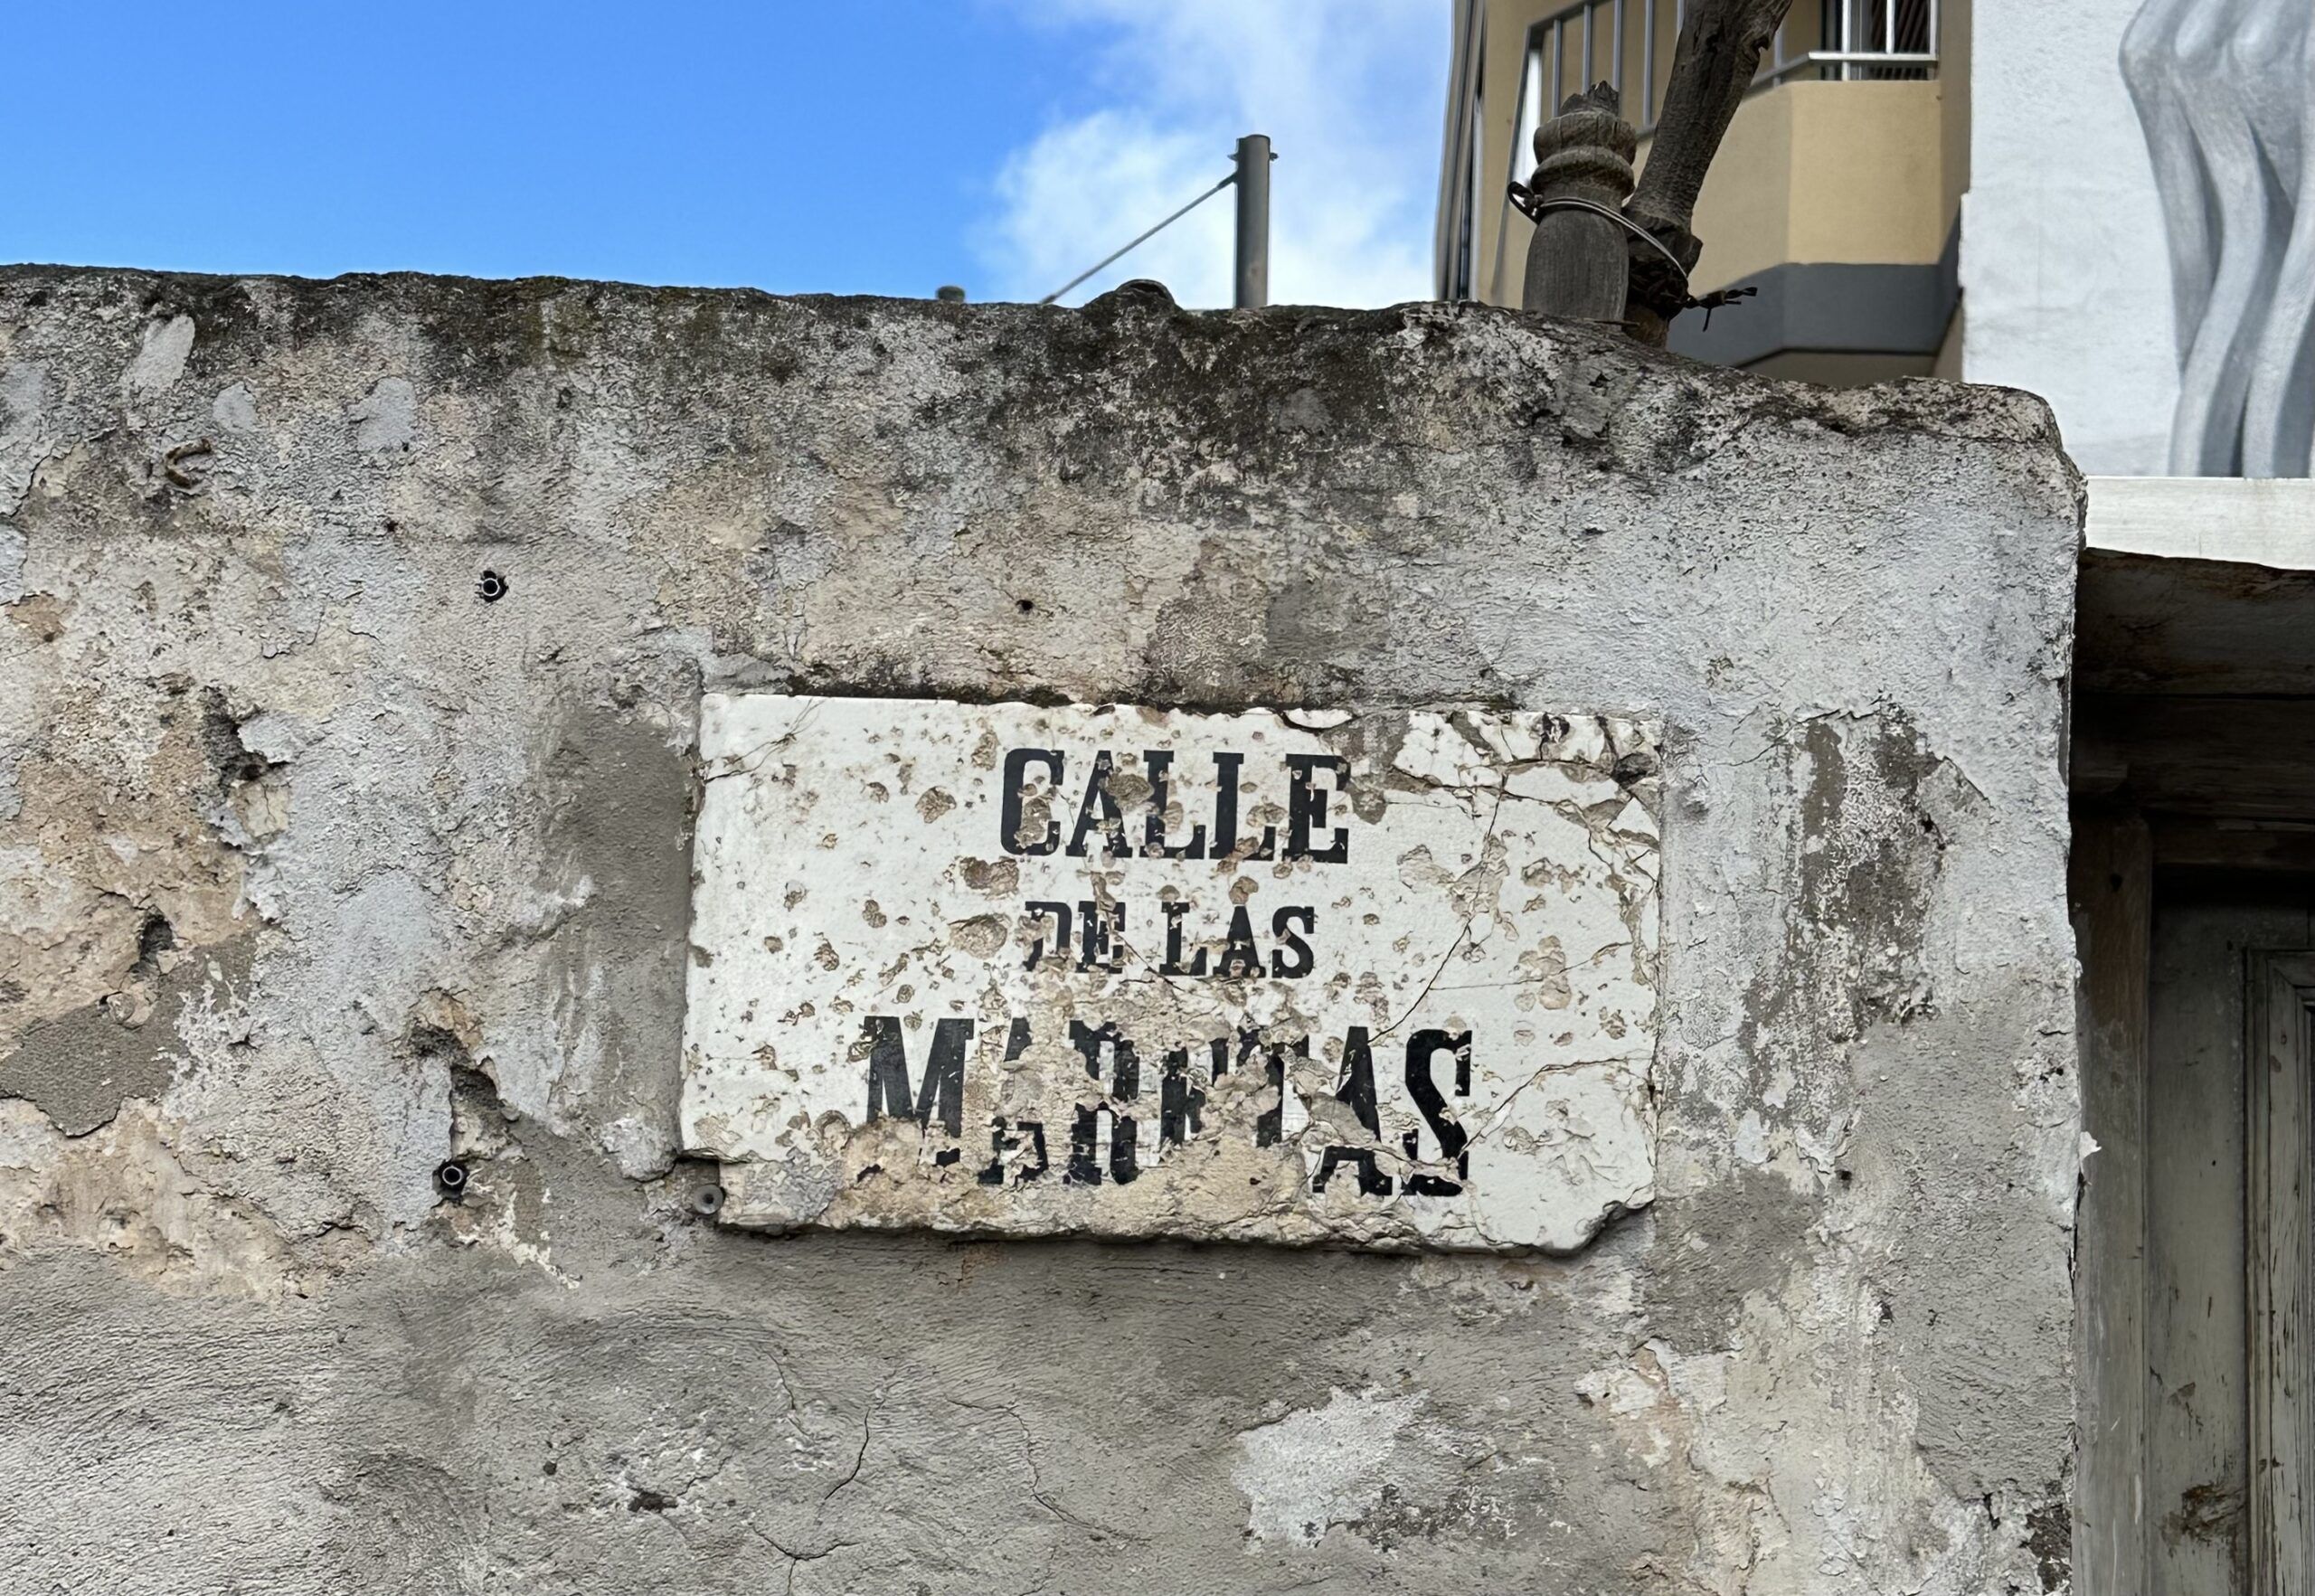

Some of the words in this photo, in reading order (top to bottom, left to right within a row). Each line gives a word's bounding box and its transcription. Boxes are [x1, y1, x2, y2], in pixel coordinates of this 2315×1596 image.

[1000, 748, 1352, 864] CALLE
[1023, 901, 1127, 975] DE
[1158, 901, 1316, 979] LAS
